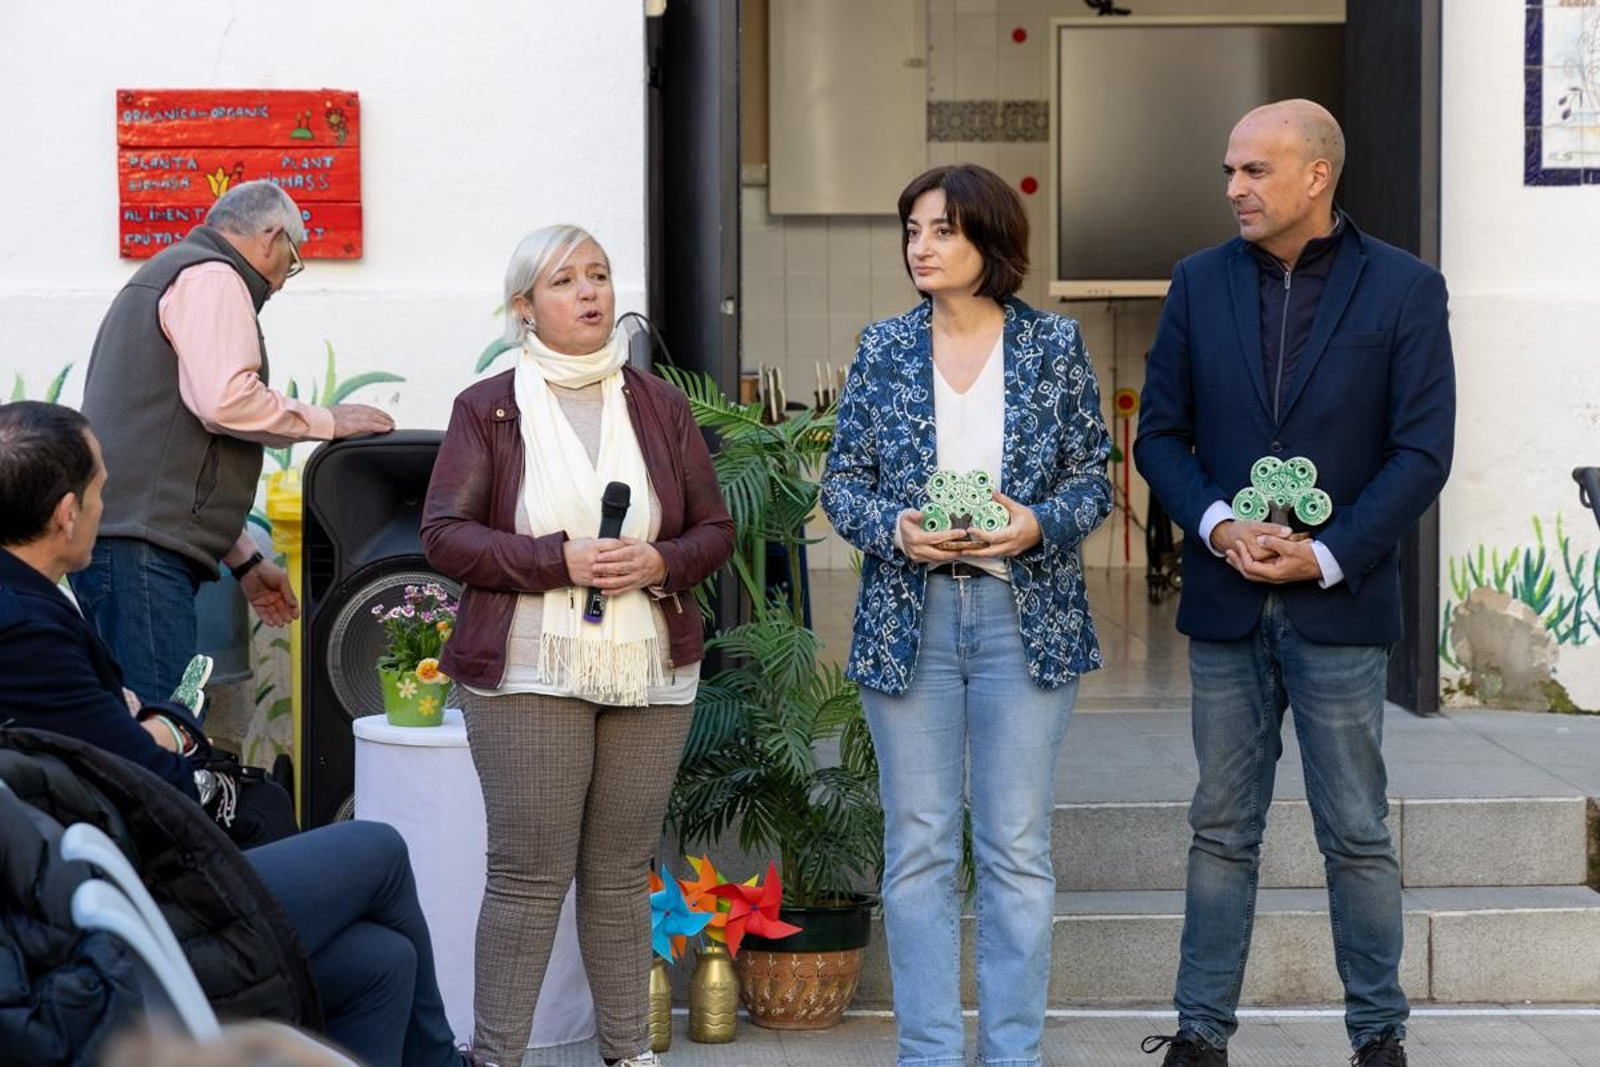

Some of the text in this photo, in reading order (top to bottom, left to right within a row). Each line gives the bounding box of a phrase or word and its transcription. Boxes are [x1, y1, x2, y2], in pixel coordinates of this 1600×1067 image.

[128, 155, 198, 170] PLANTA
[281, 155, 334, 170] PLANT
[265, 170, 330, 192] IOMASS
[124, 205, 205, 222] ALIMENT
